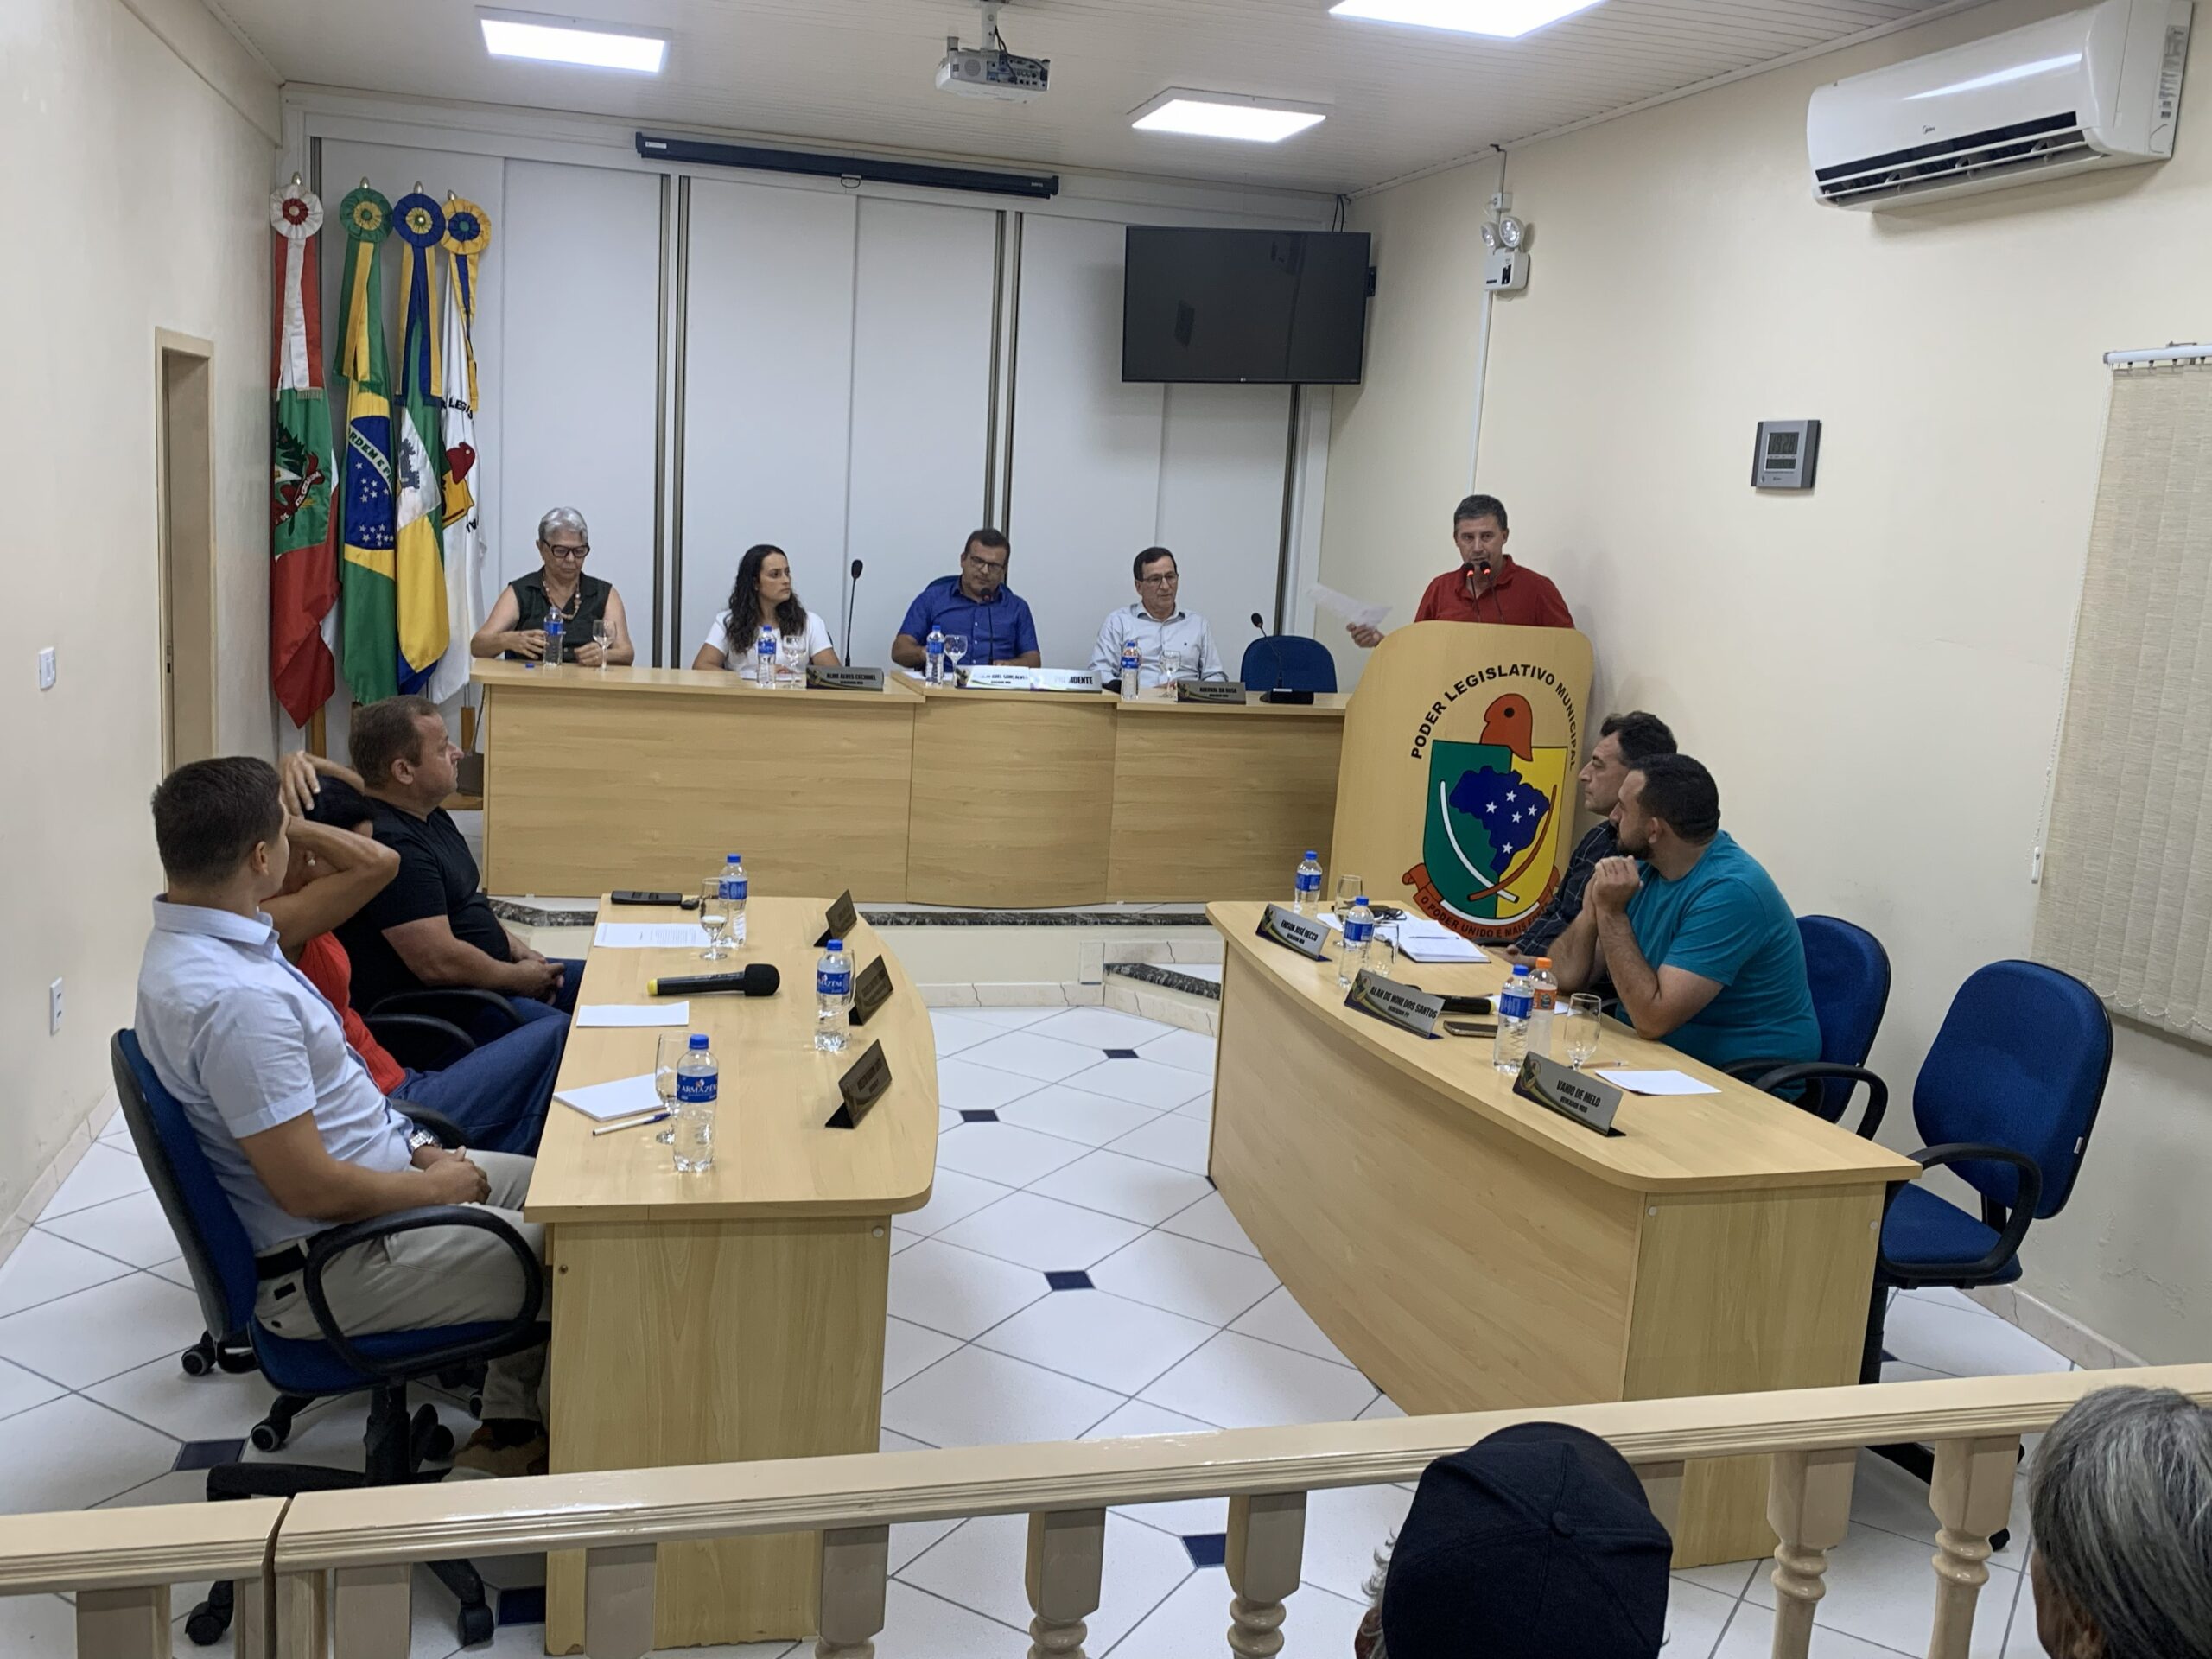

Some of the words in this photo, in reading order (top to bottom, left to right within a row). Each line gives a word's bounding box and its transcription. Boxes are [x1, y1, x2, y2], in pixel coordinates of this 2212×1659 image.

[348, 426, 378, 460] RDEM
[377, 459, 385, 467] E
[1411, 701, 1447, 760] PODER
[1444, 664, 1555, 702] LEGISLATIVO
[1555, 682, 1577, 772] MUNICIPAL
[1420, 895, 1428, 906] O
[1428, 902, 1459, 929] PODER
[1460, 923, 1494, 938] UNIDO
[1503, 921, 1527, 937] MAIS
[1369, 986, 1383, 999] ALAN
[1382, 991, 1391, 1002] DE
[1402, 998, 1416, 1012] DOS
[1414, 1003, 1439, 1020] SANTOS
[1574, 1088, 1585, 1100] DE
[1583, 1091, 1601, 1107] MELO
